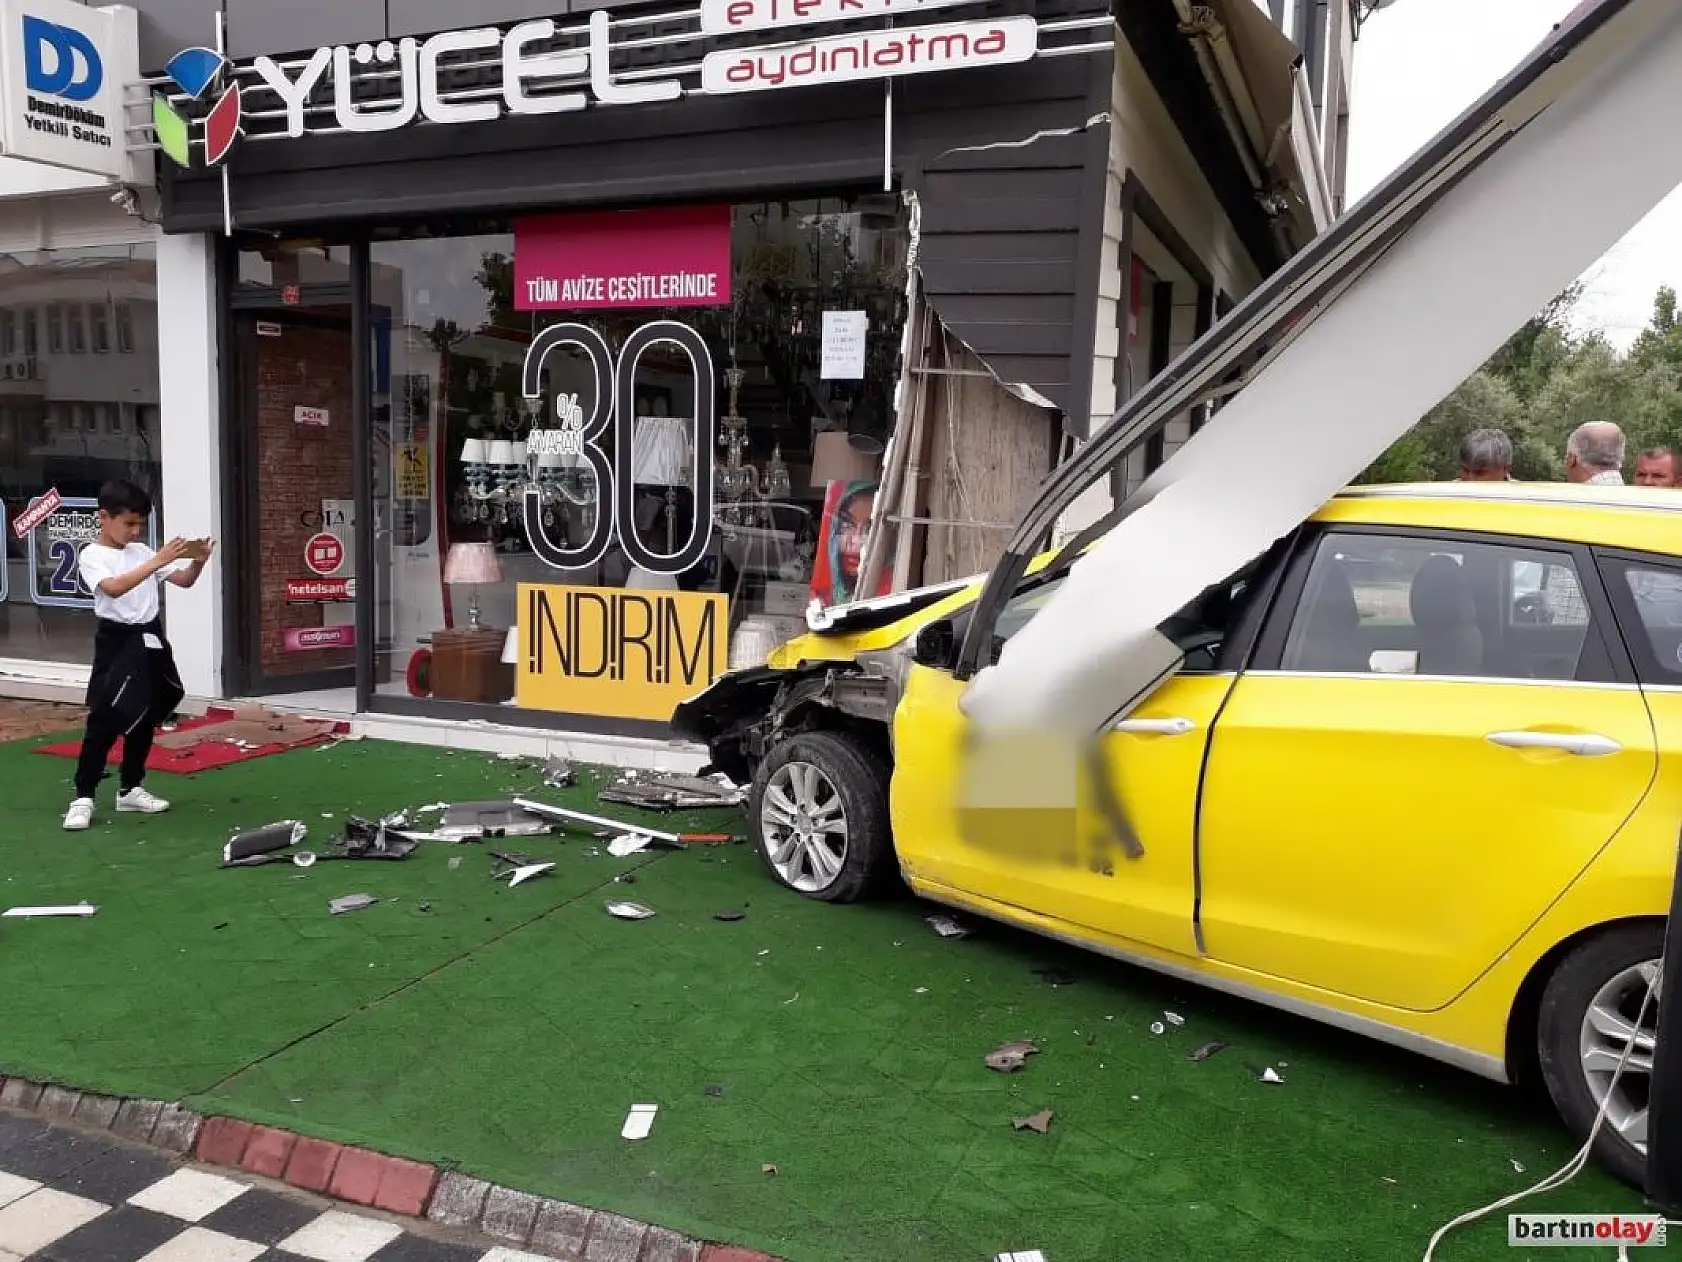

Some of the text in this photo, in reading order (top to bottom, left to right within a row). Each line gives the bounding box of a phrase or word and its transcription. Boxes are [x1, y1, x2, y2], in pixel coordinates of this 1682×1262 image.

[254, 10, 681, 138] YÜCEL
[726, 28, 1006, 85] aydınlatma
[24, 113, 69, 137] Yetkili
[526, 275, 558, 303] TÜM
[562, 273, 605, 302] AVİZE
[522, 321, 714, 575] 30
